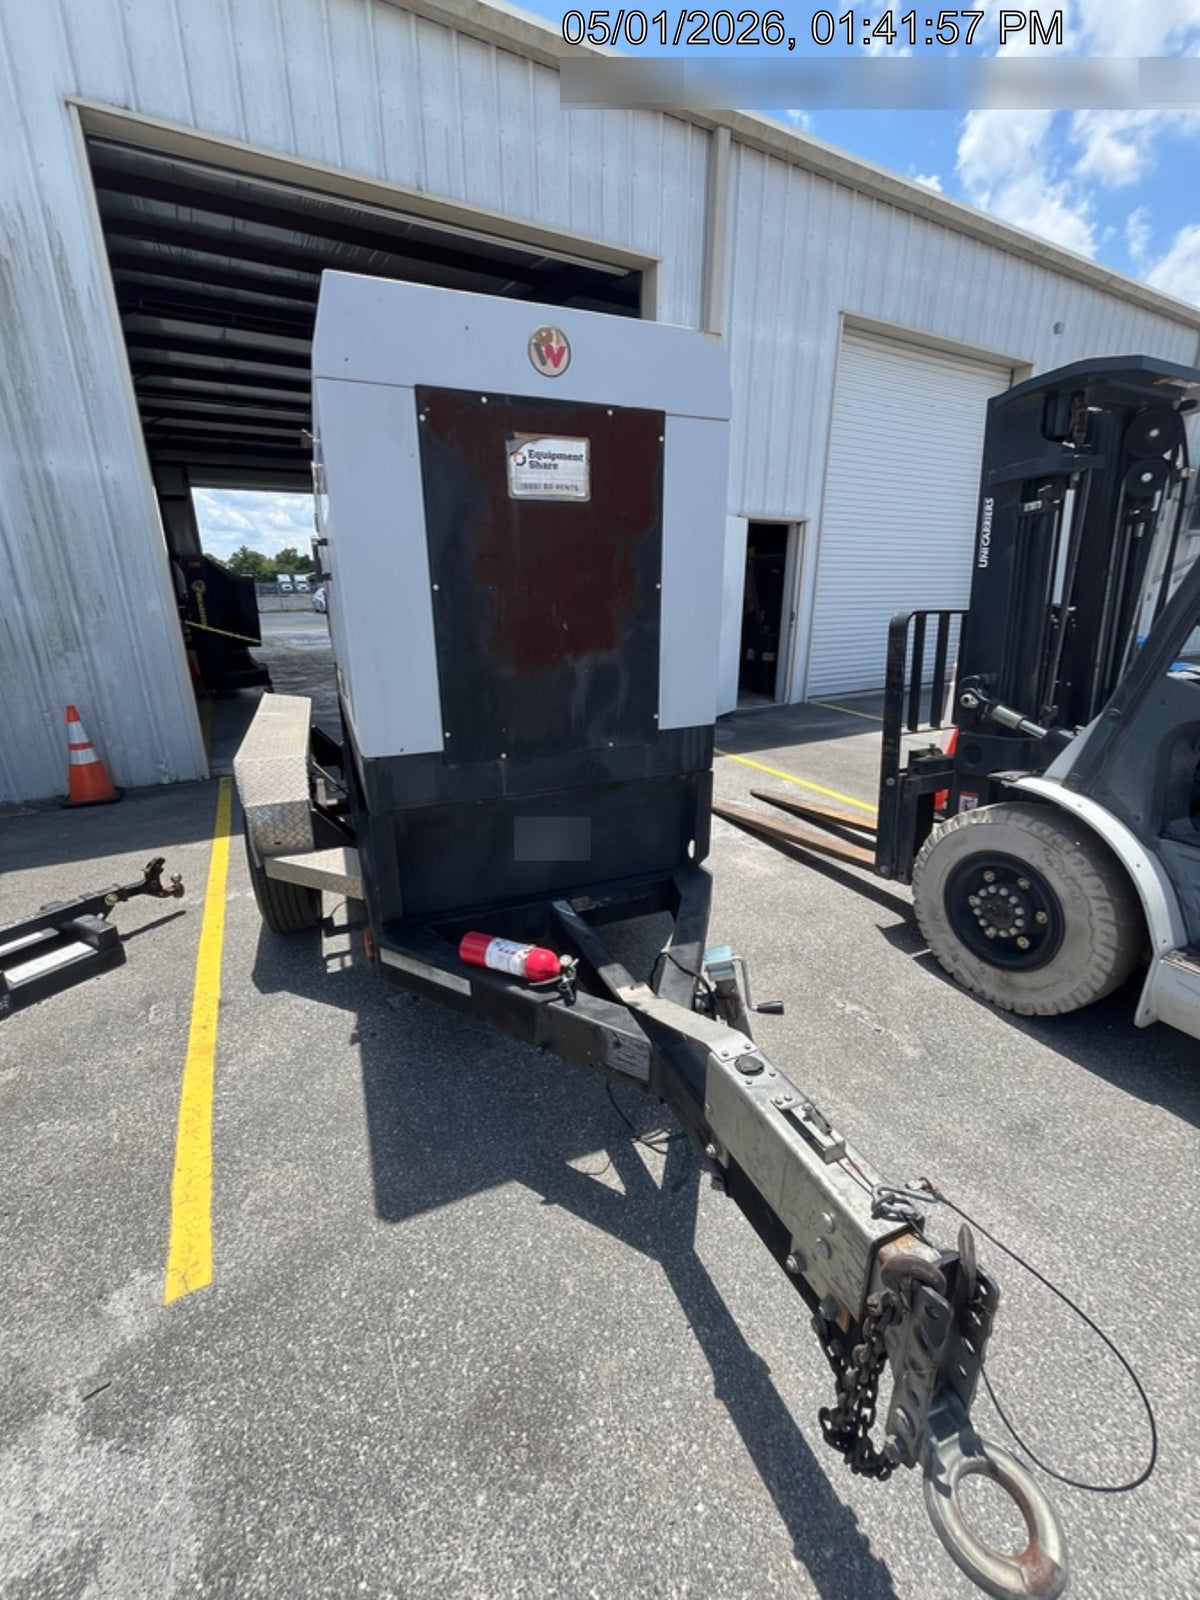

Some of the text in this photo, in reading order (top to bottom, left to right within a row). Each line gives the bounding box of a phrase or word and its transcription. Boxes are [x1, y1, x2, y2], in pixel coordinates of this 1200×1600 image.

[528, 450, 584, 462] Equipment
[528, 460, 559, 470] Share
[978, 497, 994, 568] UNICARRIERS
